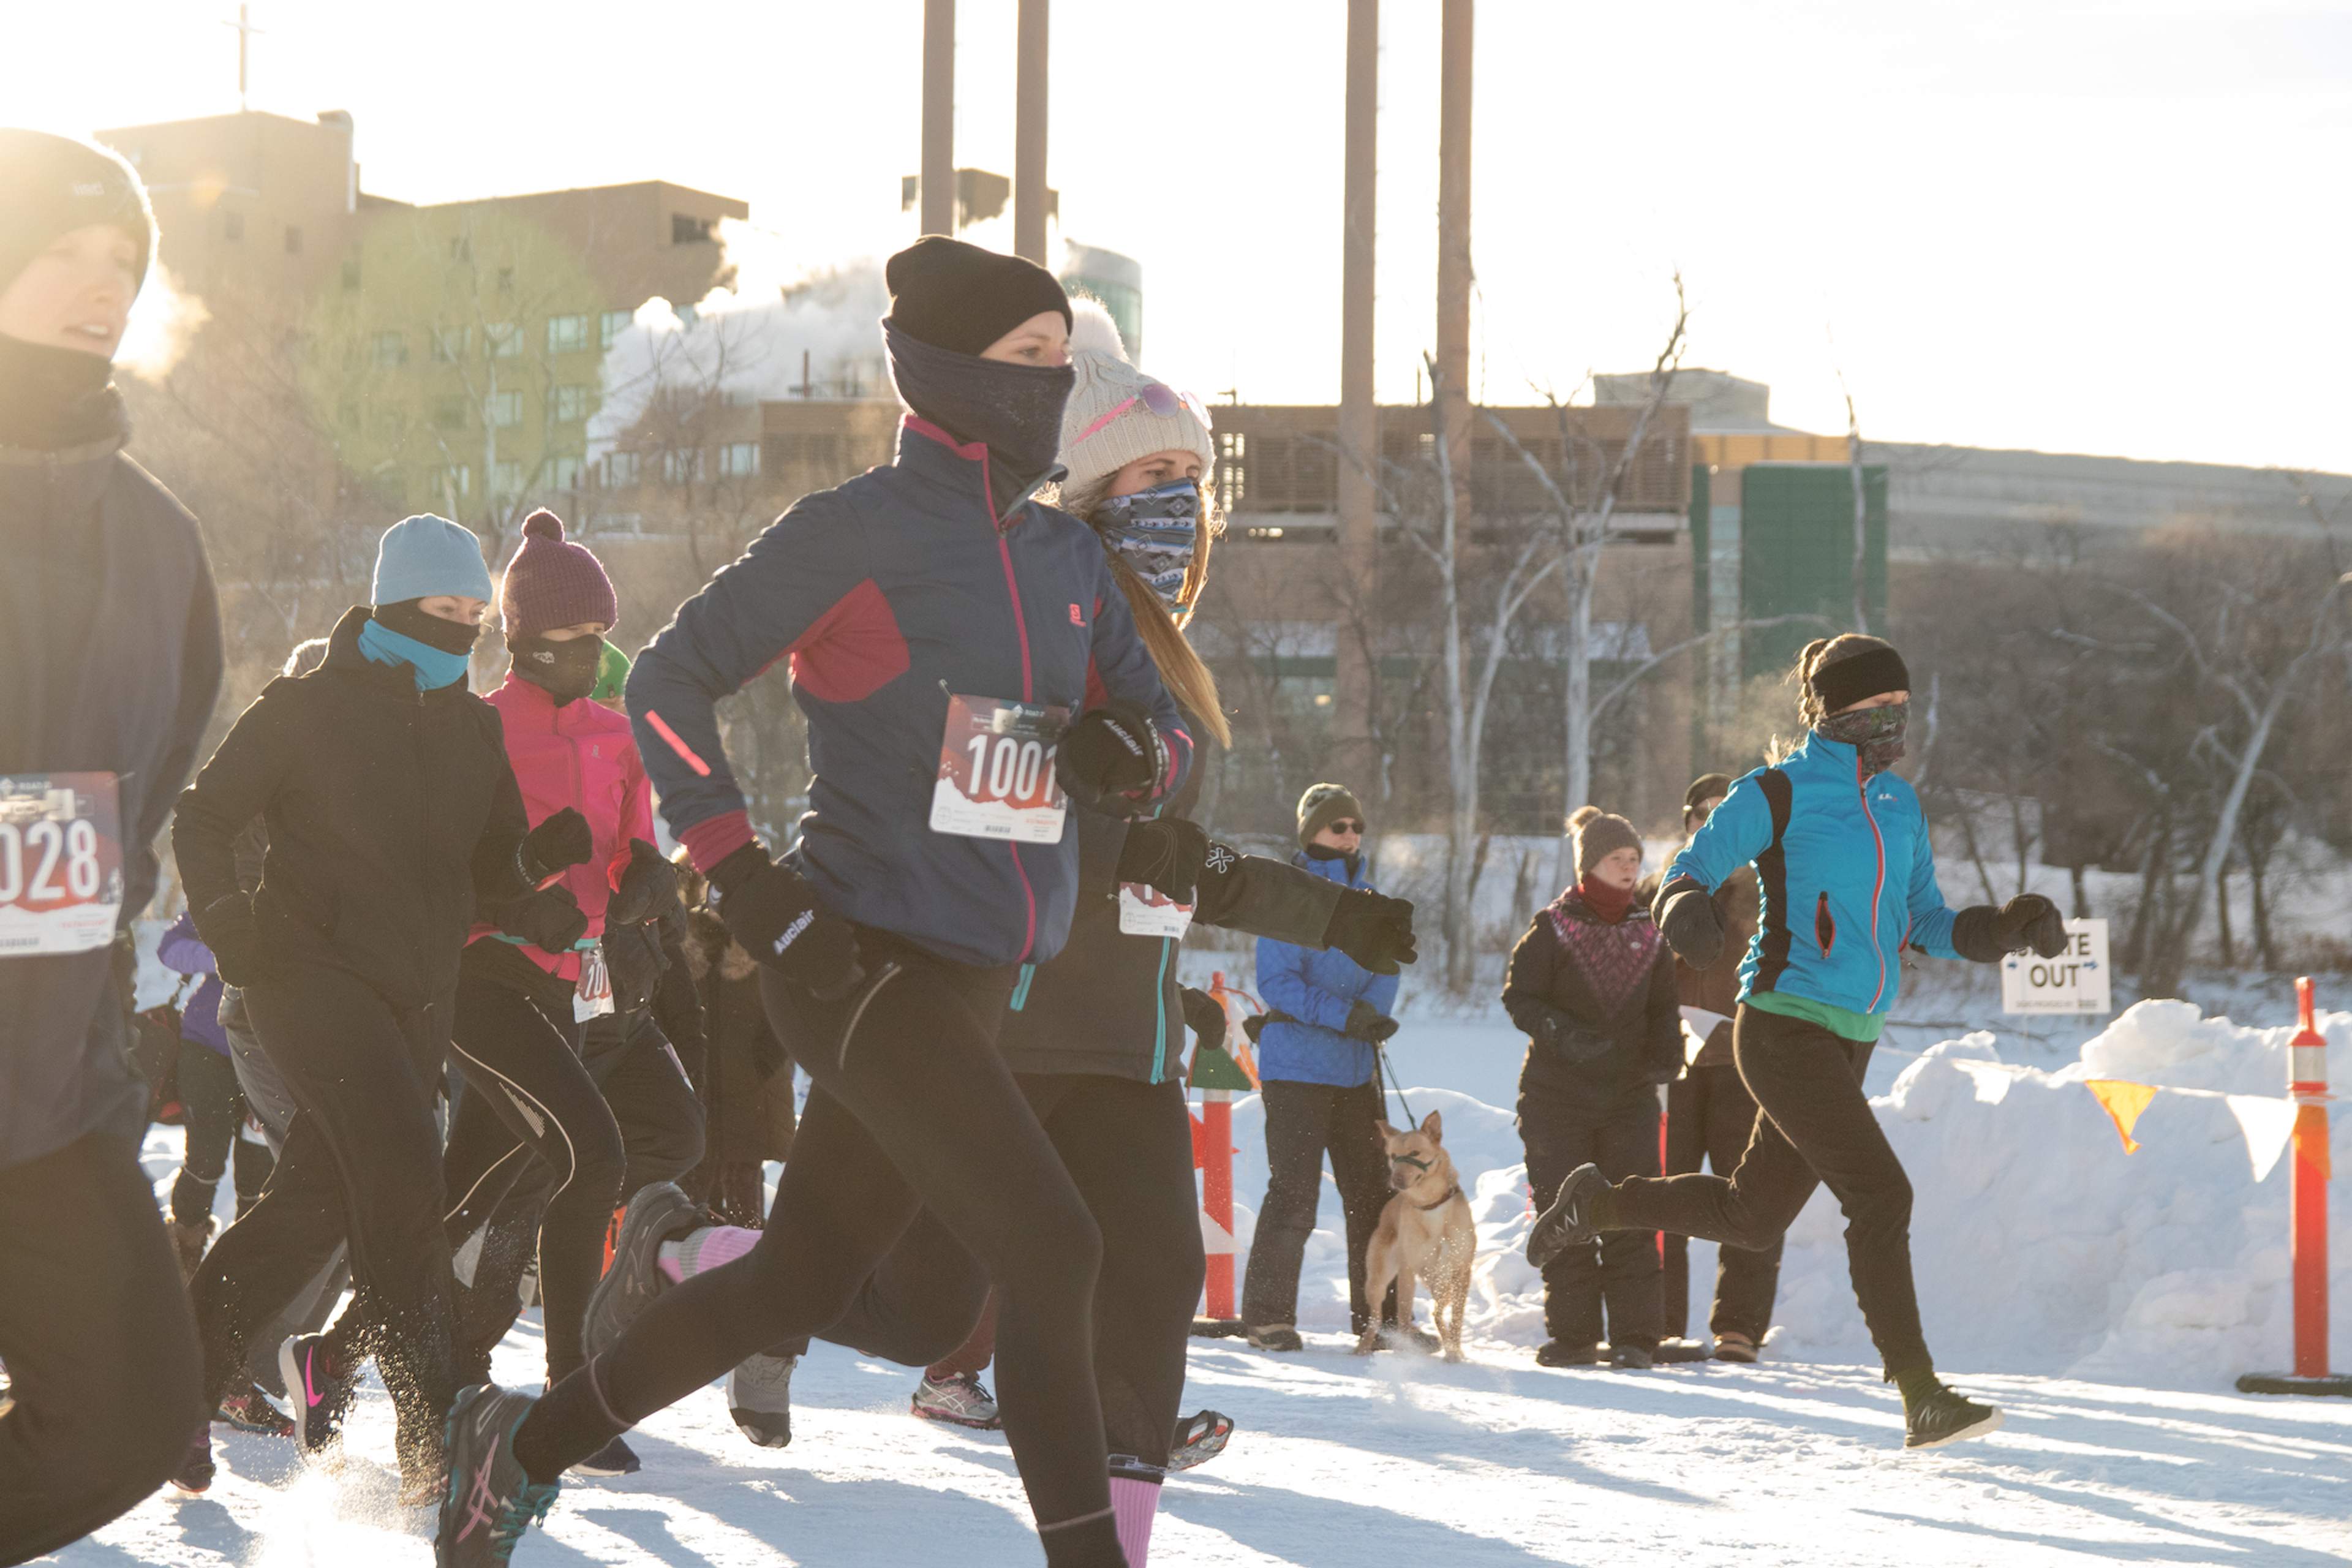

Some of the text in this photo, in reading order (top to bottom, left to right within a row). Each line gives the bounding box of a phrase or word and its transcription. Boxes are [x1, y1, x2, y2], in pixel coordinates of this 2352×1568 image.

[1102, 718, 1144, 756] Auclair
[967, 734, 1058, 802] 1001
[774, 909, 815, 956] Auclair
[2030, 963, 2080, 988] OUT
